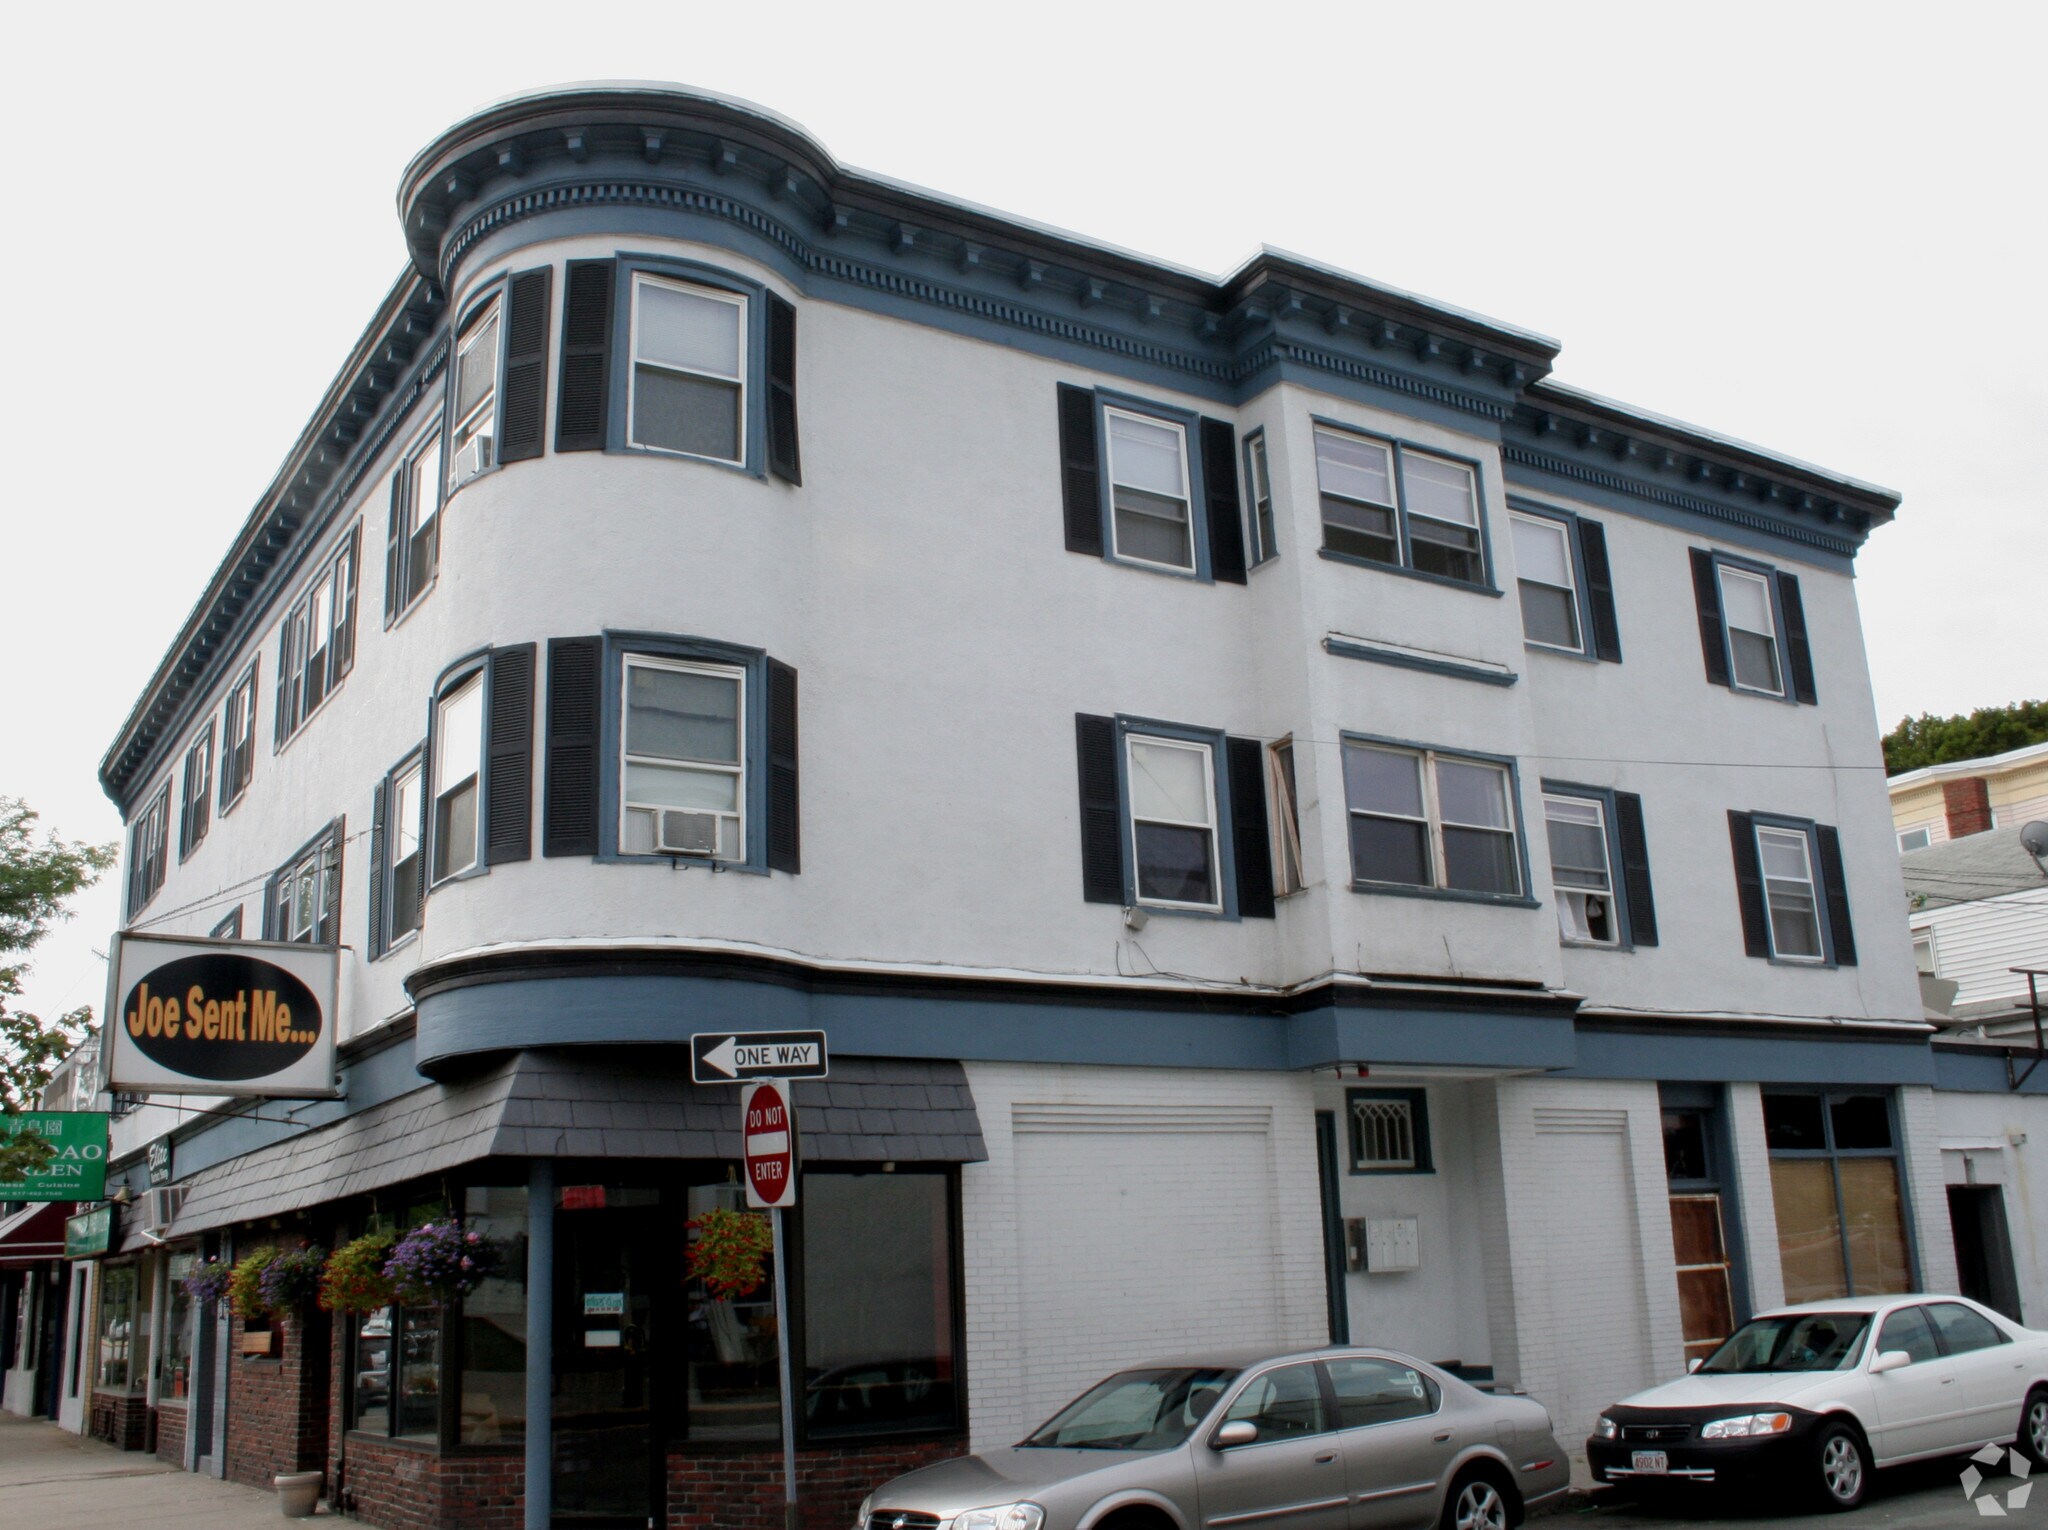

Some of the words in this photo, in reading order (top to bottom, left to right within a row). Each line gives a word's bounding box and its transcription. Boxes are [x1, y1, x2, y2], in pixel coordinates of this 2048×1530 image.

[128, 982, 181, 1038] Joe
[184, 984, 247, 1041] Sent
[250, 989, 316, 1044] Me...
[734, 1047, 771, 1066] ONE
[776, 1046, 812, 1065] WAY
[749, 1110, 762, 1128] DO
[765, 1106, 782, 1125] NOT
[149, 1143, 168, 1171] Elite
[755, 1161, 783, 1181] ENTER
[1634, 1456, 1653, 1468] 4902
[1654, 1456, 1664, 1468] NT
